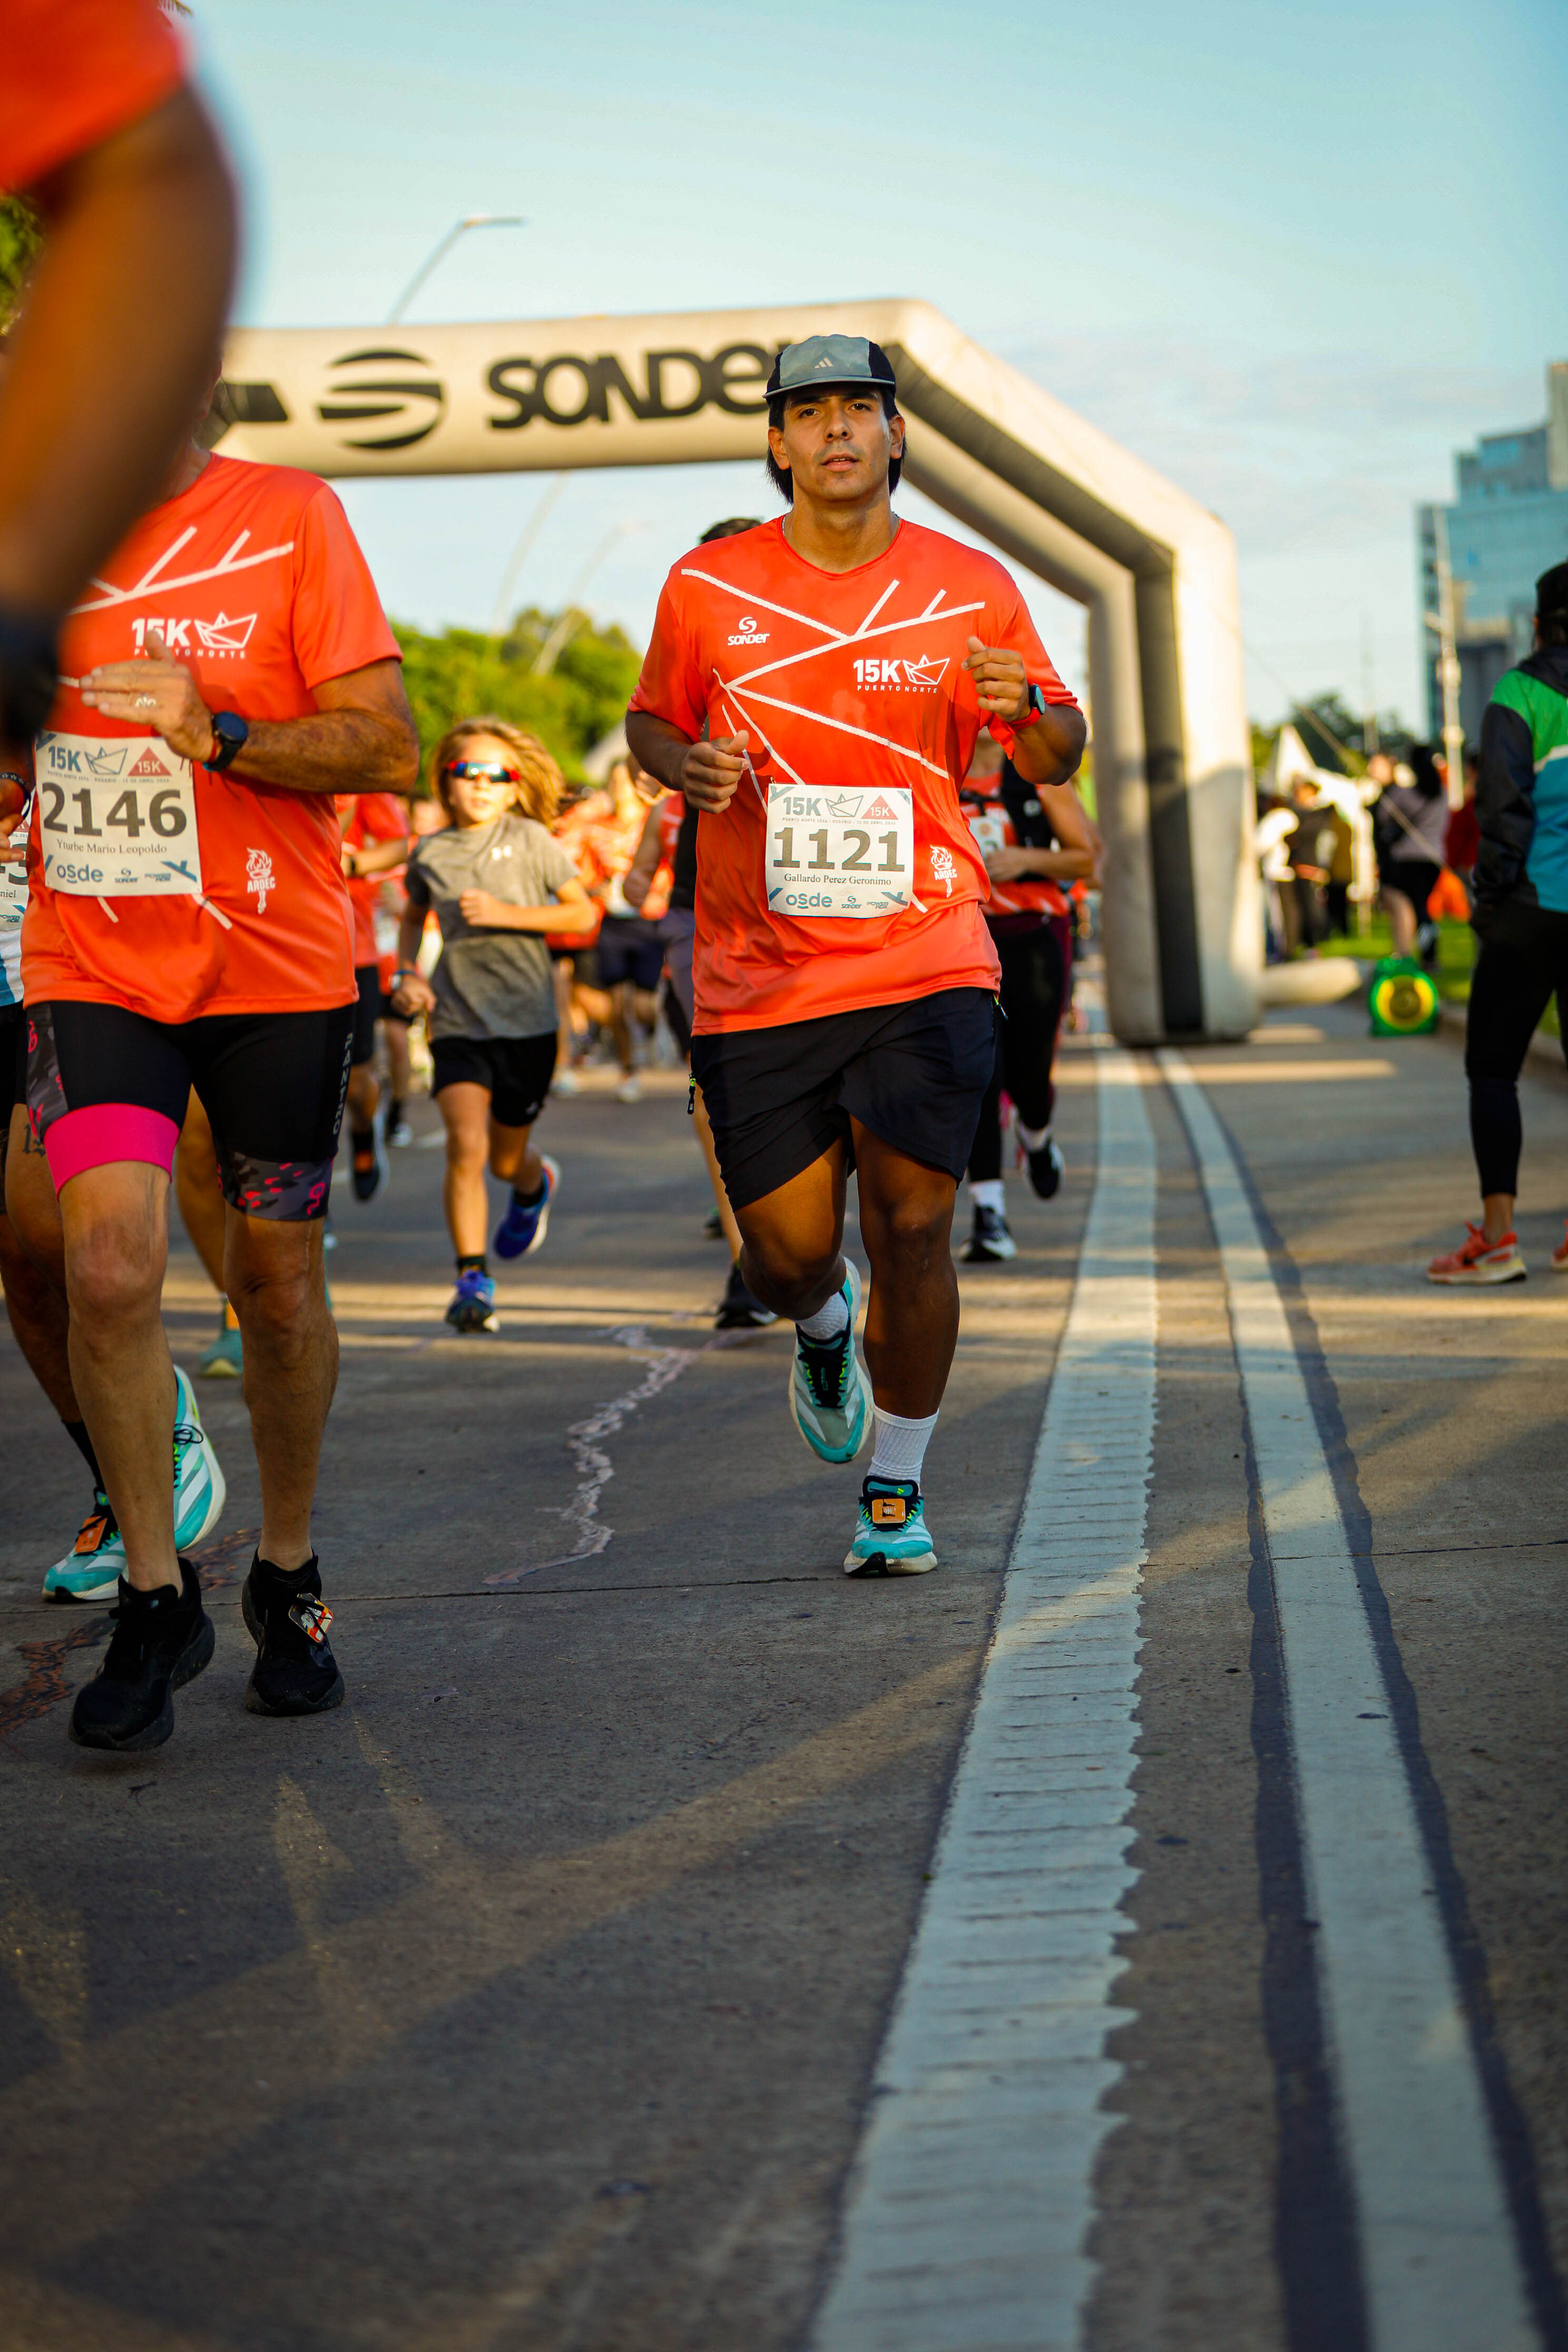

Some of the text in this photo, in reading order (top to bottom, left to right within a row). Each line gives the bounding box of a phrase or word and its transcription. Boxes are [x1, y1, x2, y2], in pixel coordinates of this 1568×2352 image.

[487, 343, 792, 429] SONDe
[197, 649, 246, 658] NORTE
[853, 660, 901, 683] 15K
[48, 745, 81, 772] 15K
[137, 760, 161, 773] 15K
[42, 782, 187, 837] 2146
[783, 797, 821, 816] 15K
[870, 806, 890, 817] 15K
[56, 839, 168, 856] Yturbe Mario Leopoldo
[773, 827, 905, 872] 1121
[56, 864, 103, 884] osde
[784, 873, 891, 885] Gallardo Perez Geronimo
[934, 868, 957, 880] ARDEC
[247, 876, 276, 893] ARDEC
[786, 892, 833, 909] osde
